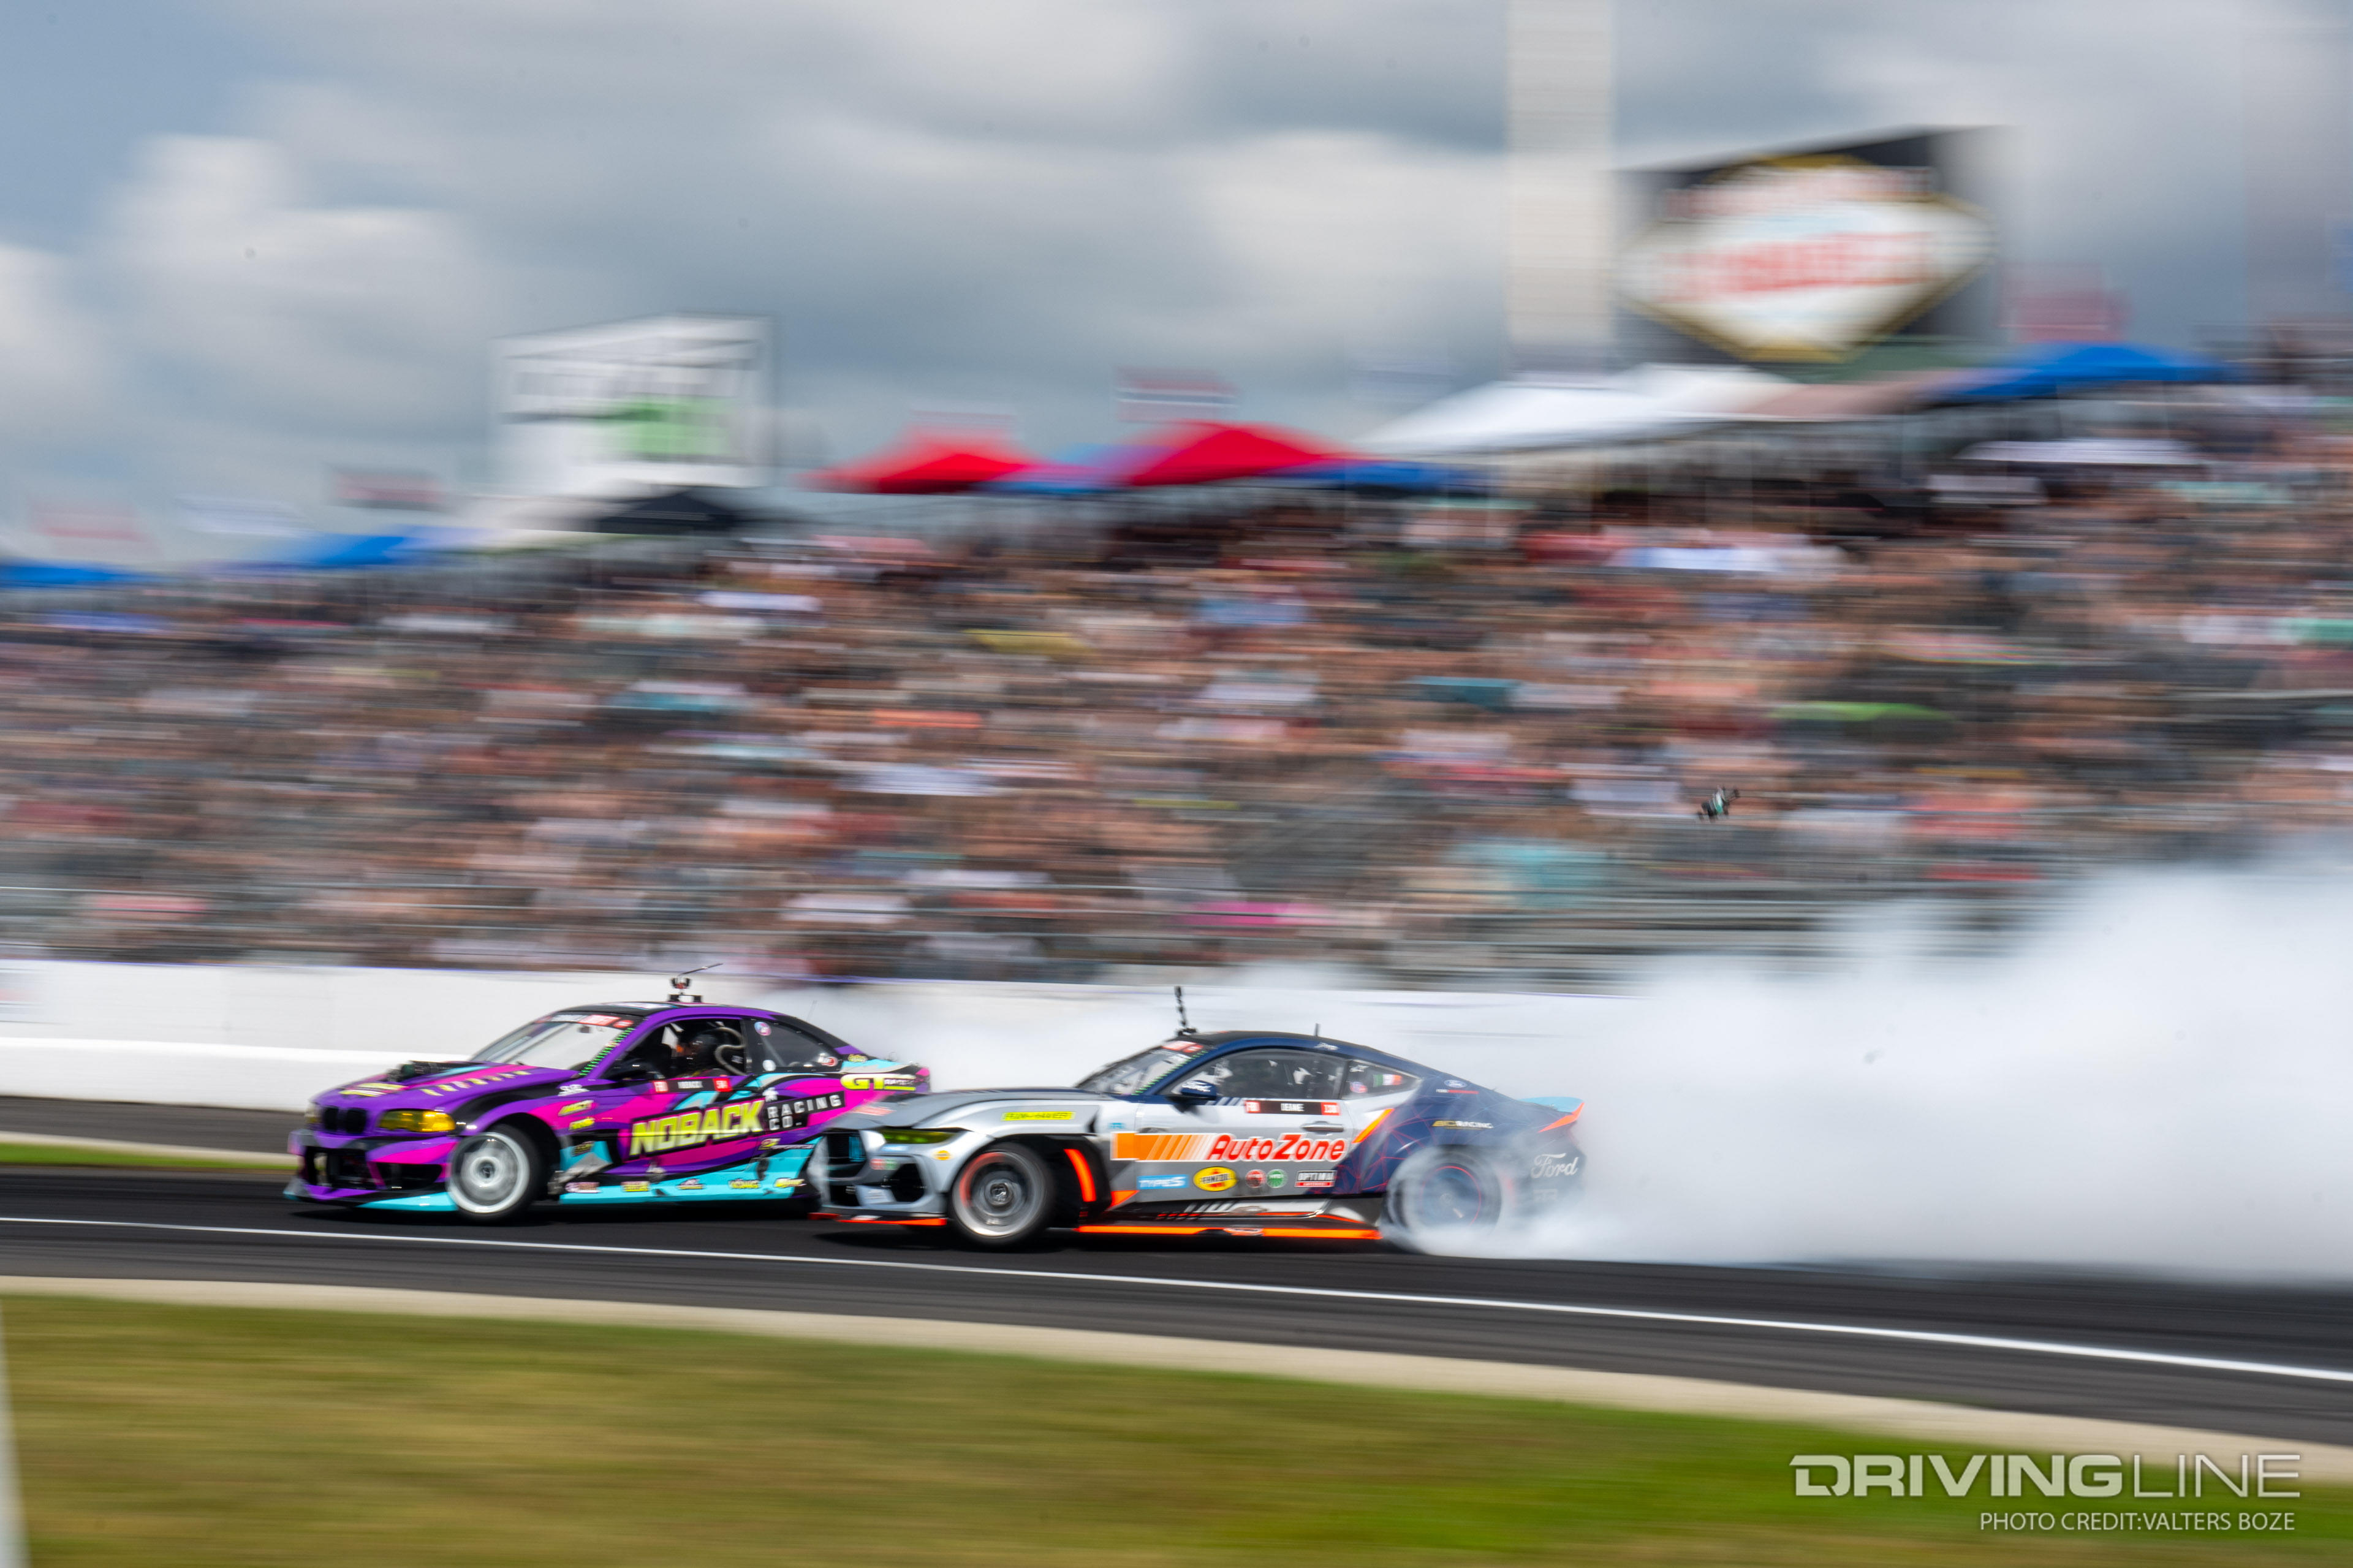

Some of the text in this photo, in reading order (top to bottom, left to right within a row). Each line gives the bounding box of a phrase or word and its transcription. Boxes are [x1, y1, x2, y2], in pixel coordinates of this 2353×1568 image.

[629, 1099, 765, 1156] NOBACK
[767, 1094, 842, 1119] RACING
[769, 1115, 802, 1131] CO.
[1206, 1134, 1345, 1161] AutoZone
[1531, 1153, 1579, 1179] Ford
